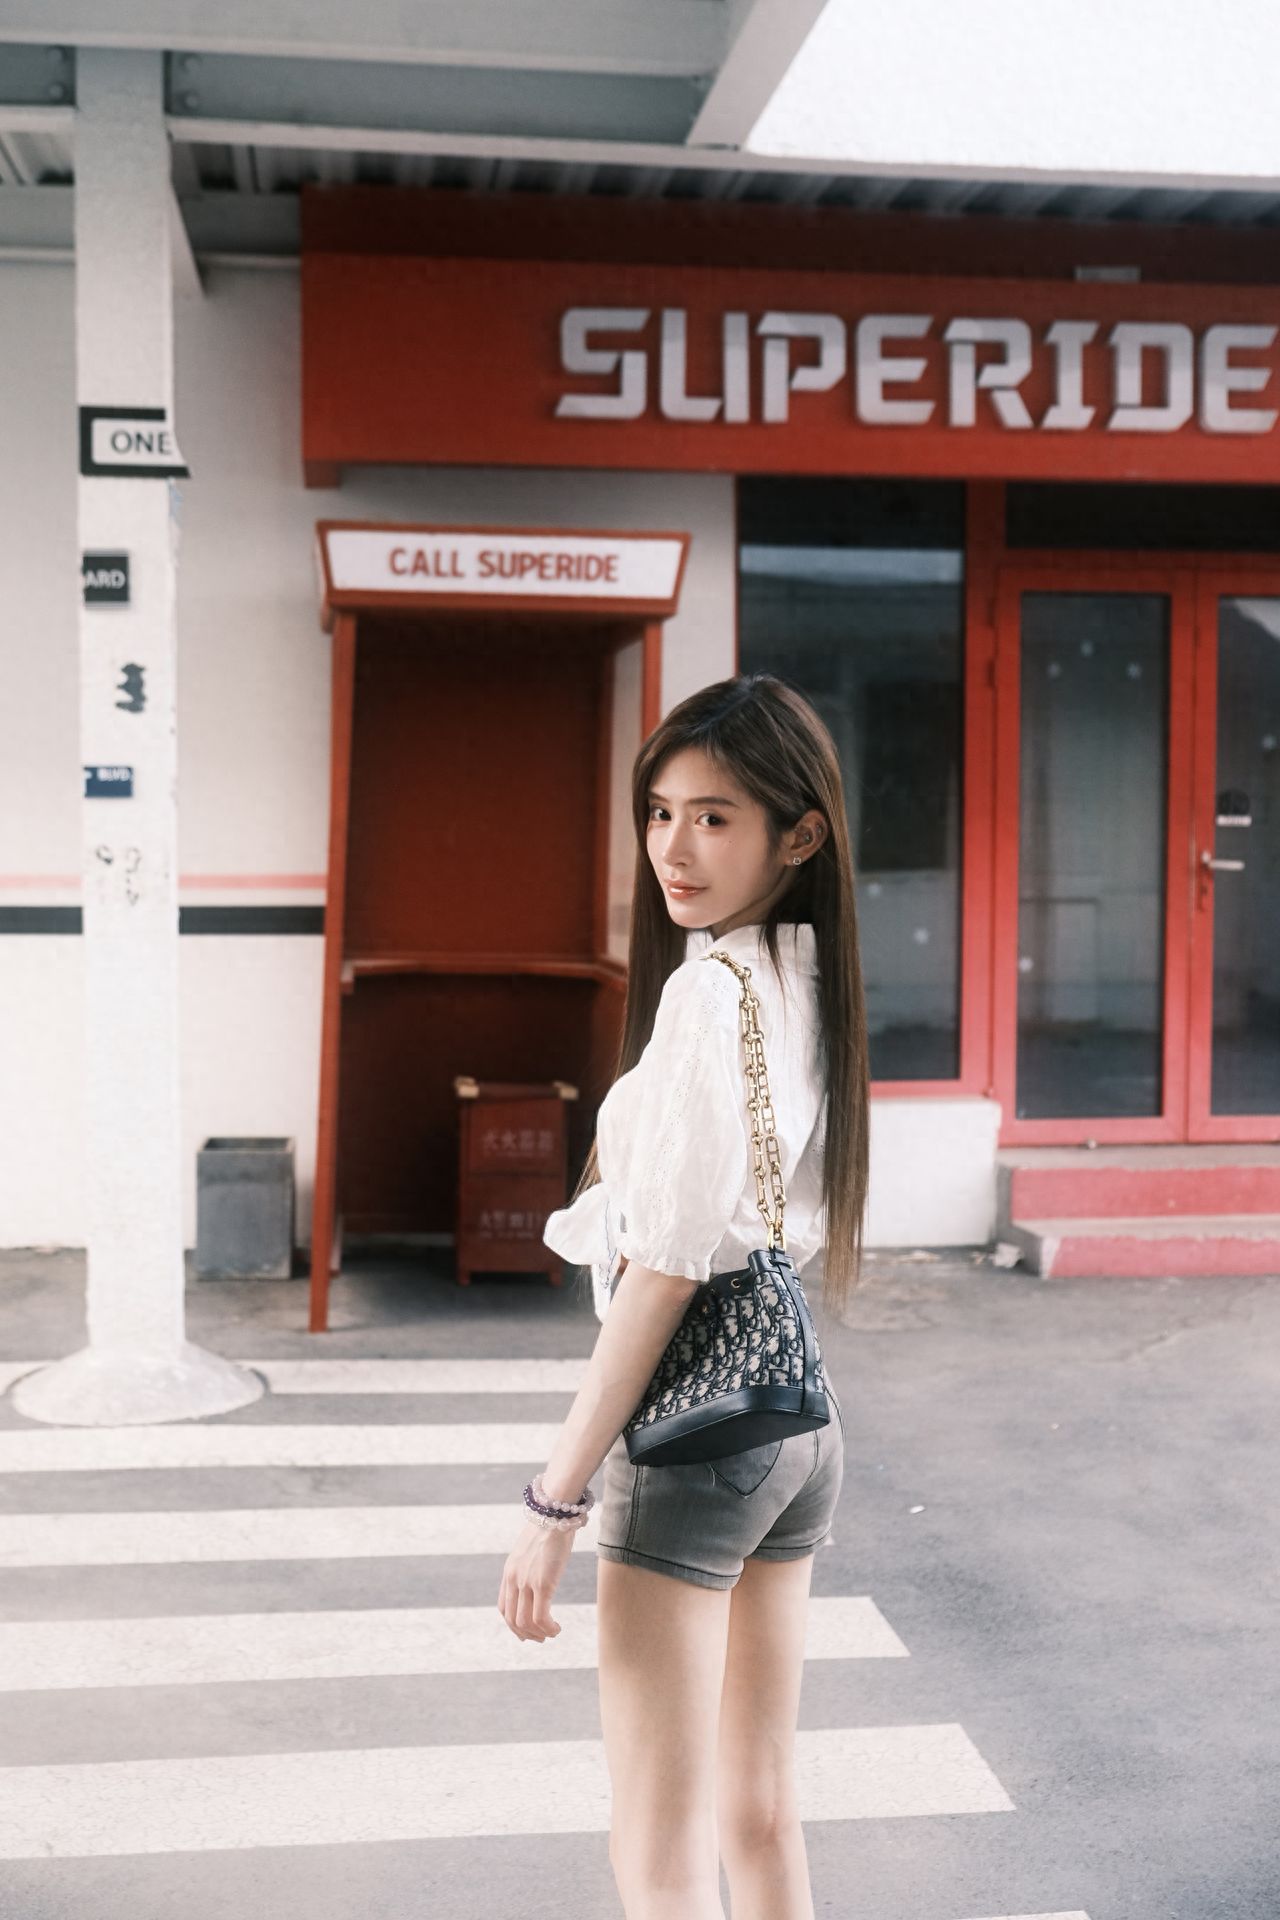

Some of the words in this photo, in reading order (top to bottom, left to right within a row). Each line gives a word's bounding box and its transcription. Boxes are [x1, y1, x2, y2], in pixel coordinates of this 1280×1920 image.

[555, 308, 1279, 433] SUPERIDE
[110, 429, 172, 456] ONE
[388, 547, 465, 578] CALL
[478, 550, 619, 582] SUPERIDE
